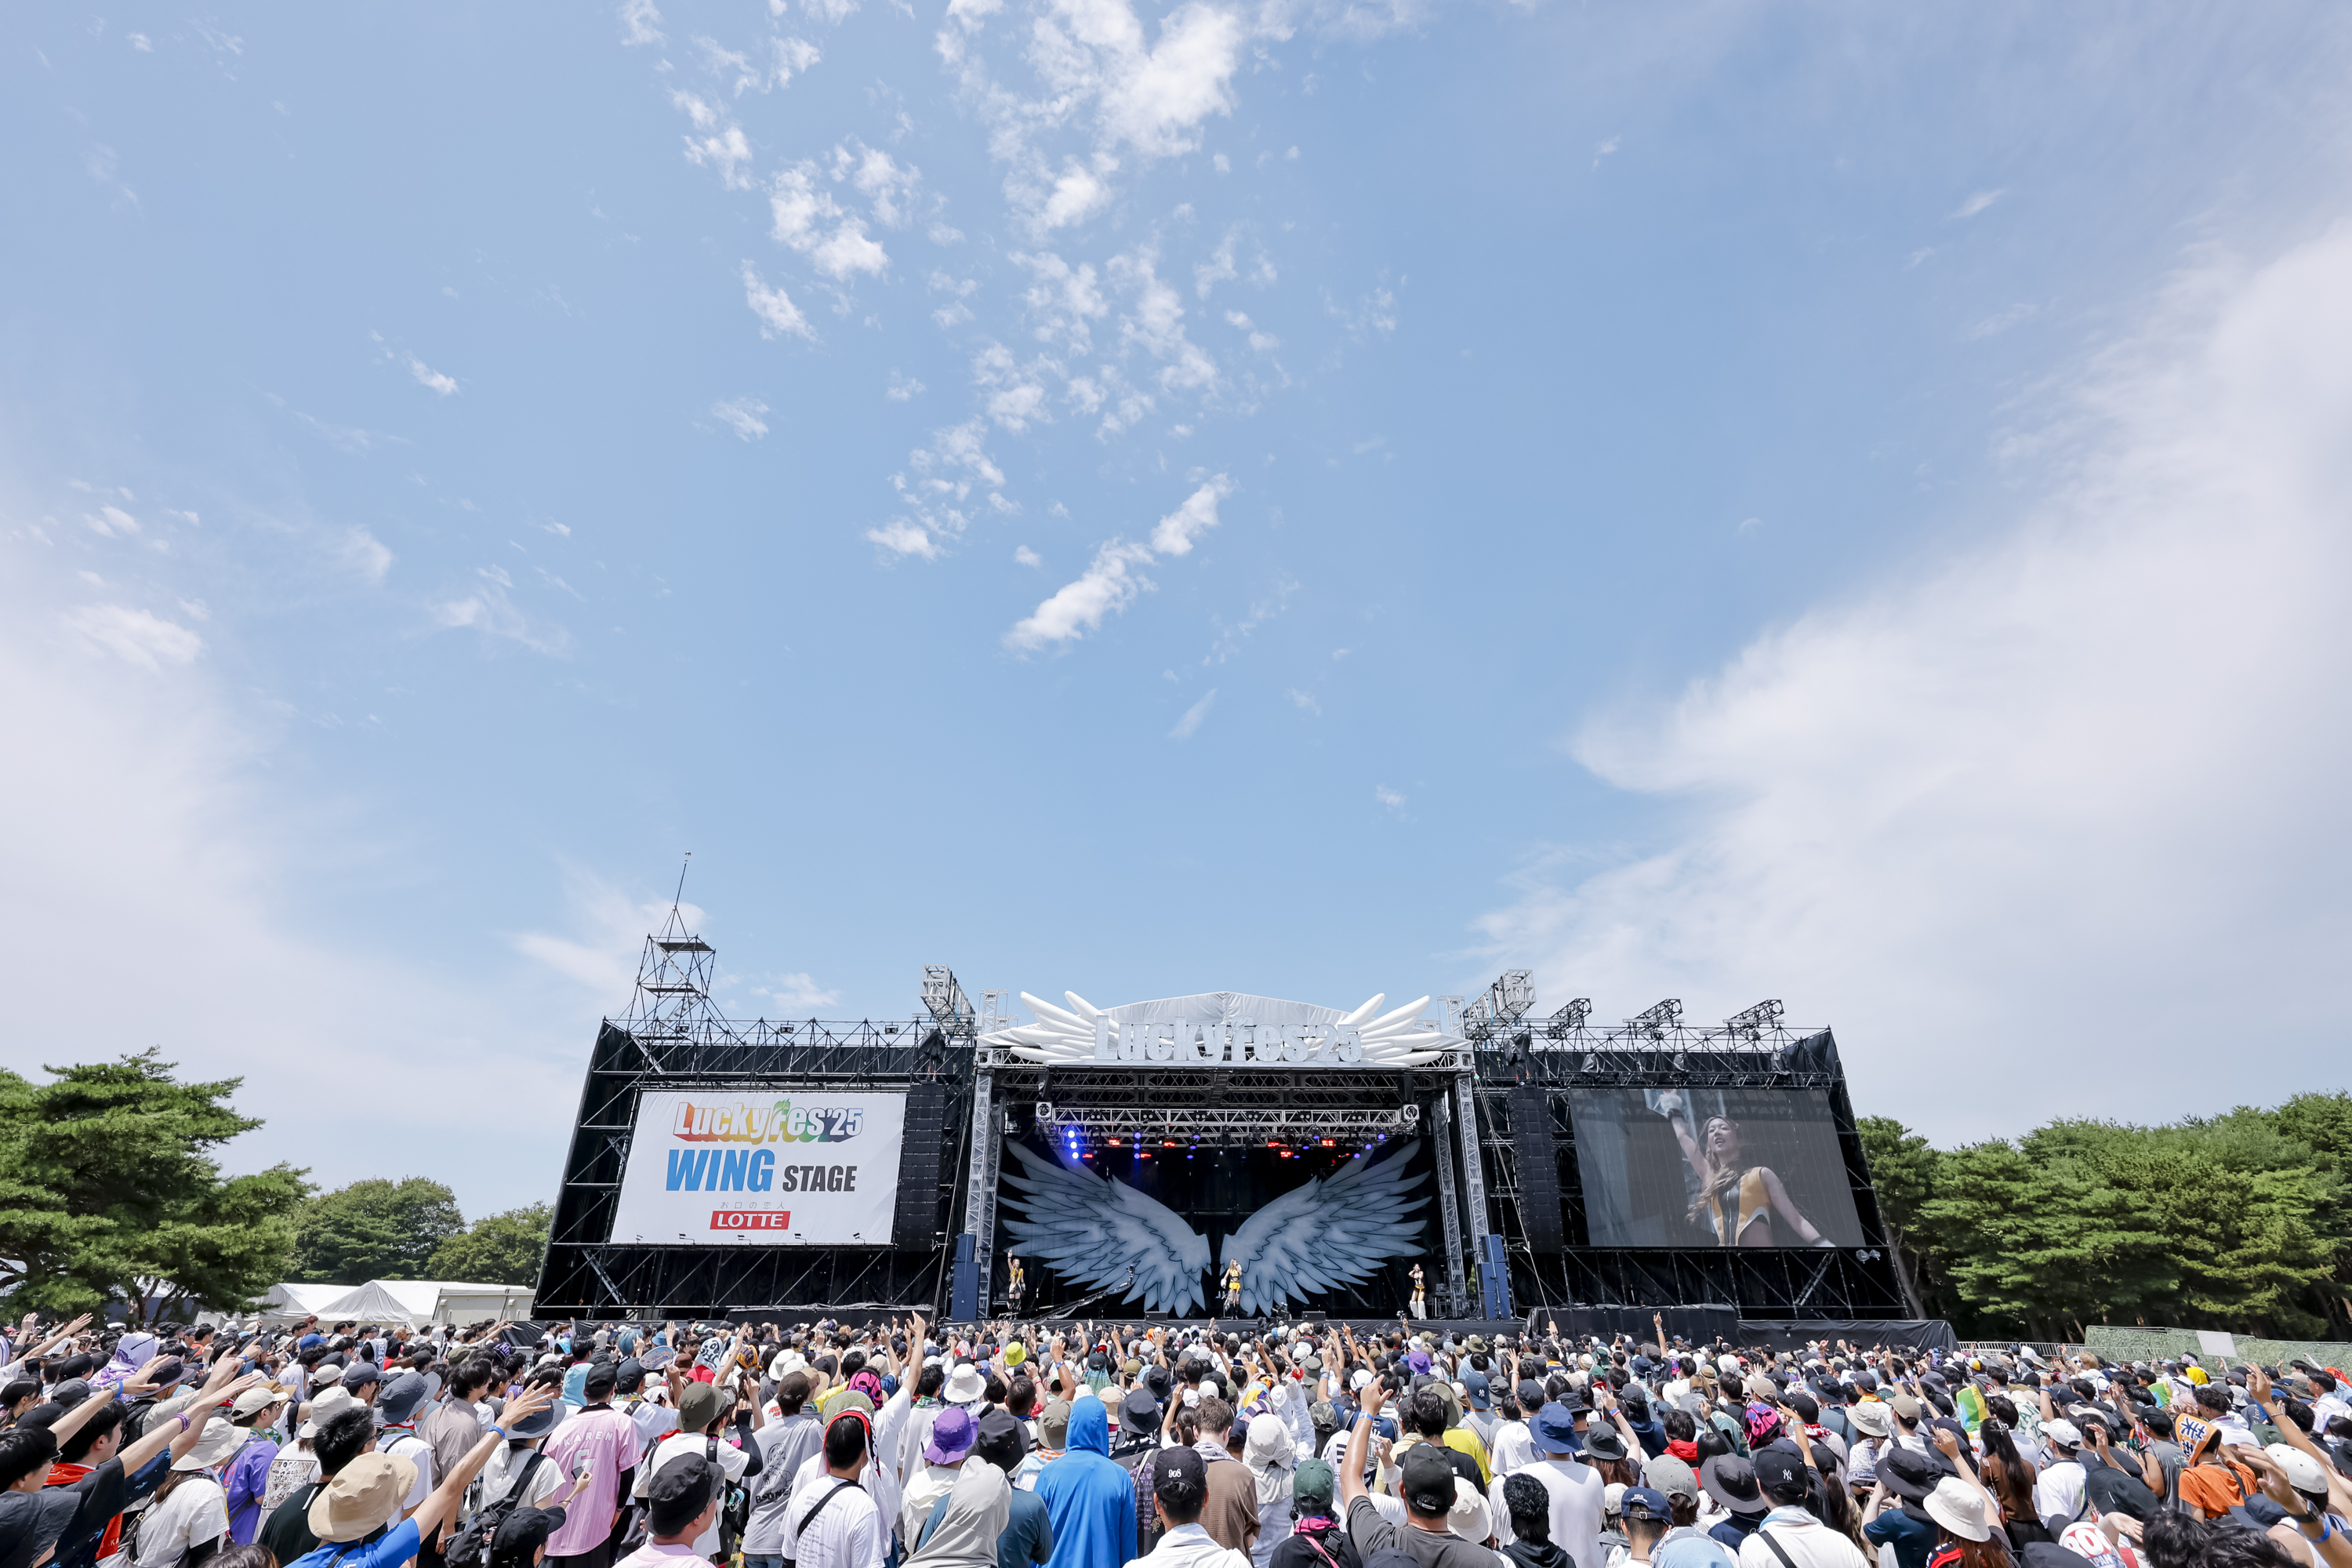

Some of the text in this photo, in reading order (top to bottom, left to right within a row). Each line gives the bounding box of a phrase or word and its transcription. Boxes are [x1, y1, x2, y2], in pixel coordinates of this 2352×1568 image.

[666, 1149, 857, 1192] WING STAGE
[720, 1201, 785, 1210] お口の恋人
[717, 1213, 784, 1228] LOTTE
[563, 1431, 614, 1447] KAREN
[1782, 1468, 1793, 1481] NY
